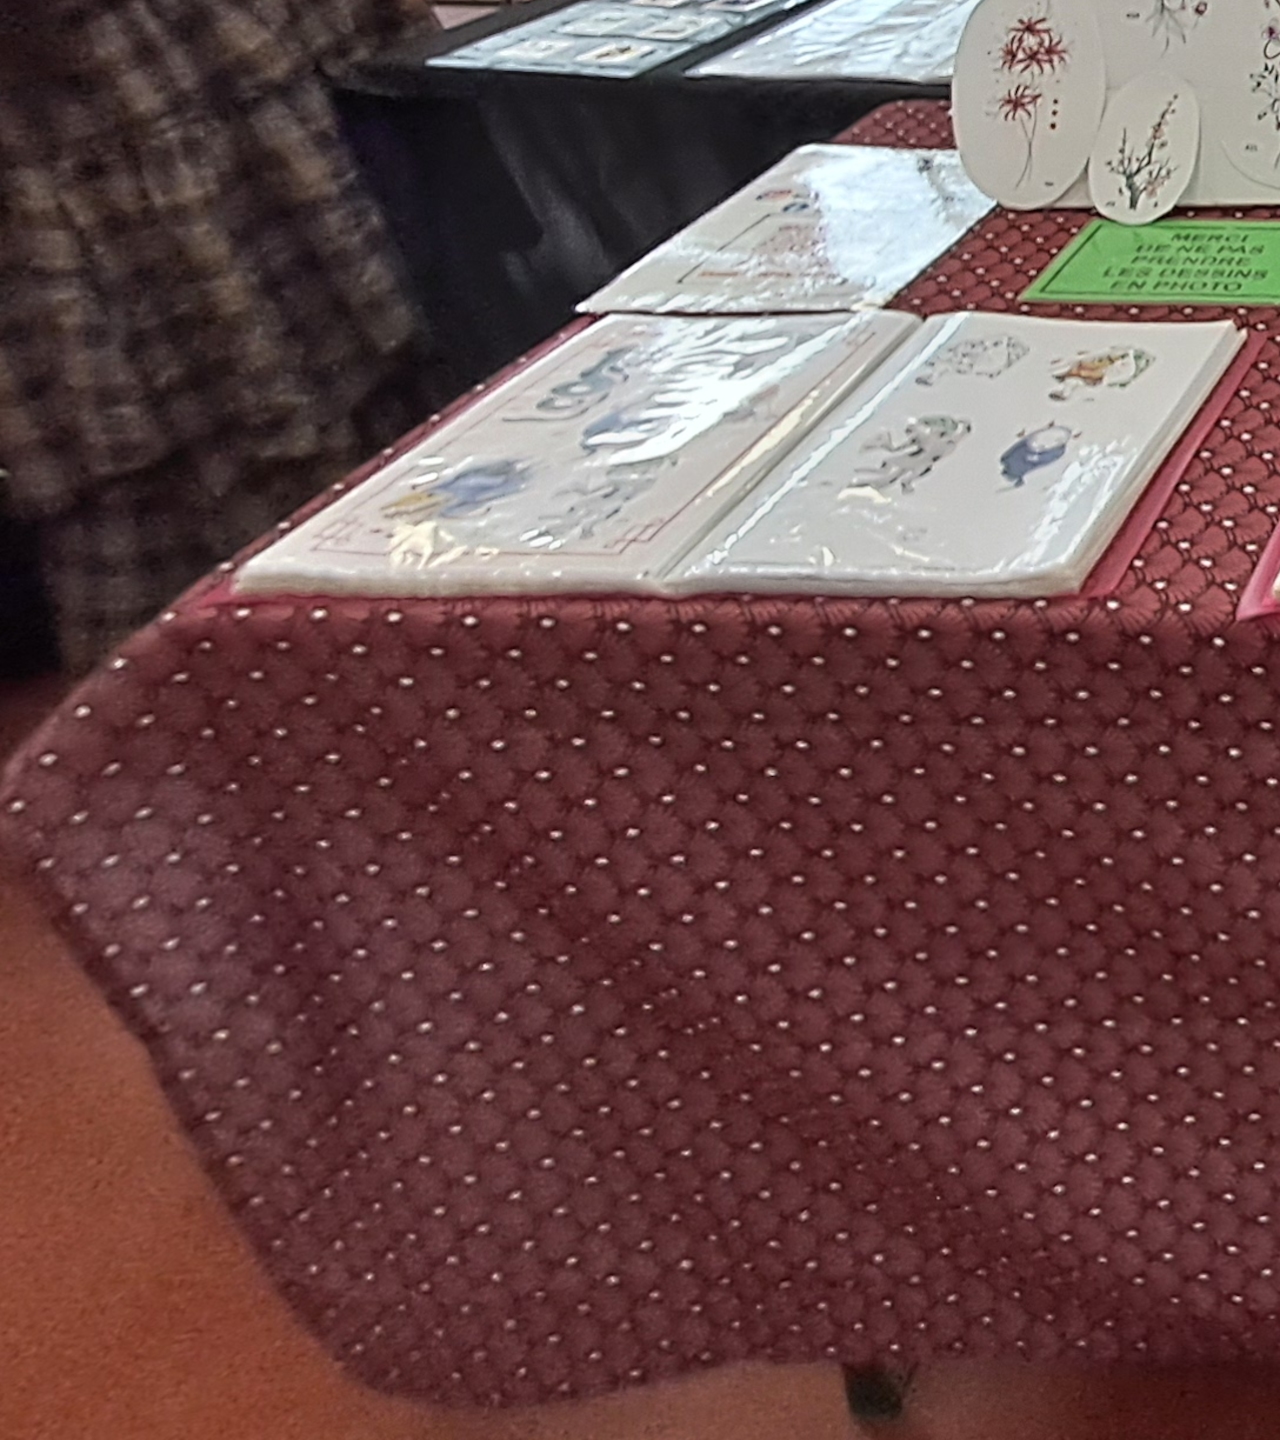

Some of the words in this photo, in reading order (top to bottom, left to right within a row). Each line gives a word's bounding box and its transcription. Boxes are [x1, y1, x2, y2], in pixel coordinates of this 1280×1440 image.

[1171, 233, 1250, 243] MERCI
[1136, 244, 1174, 255] DE
[1177, 244, 1206, 255] NE
[1216, 245, 1266, 256] PAS
[1131, 256, 1252, 267] PRENDRE
[1103, 268, 1153, 279] LES
[1159, 268, 1269, 280] DESSINS
[1110, 281, 1147, 292] EN
[1153, 281, 1243, 292] PHOTO
